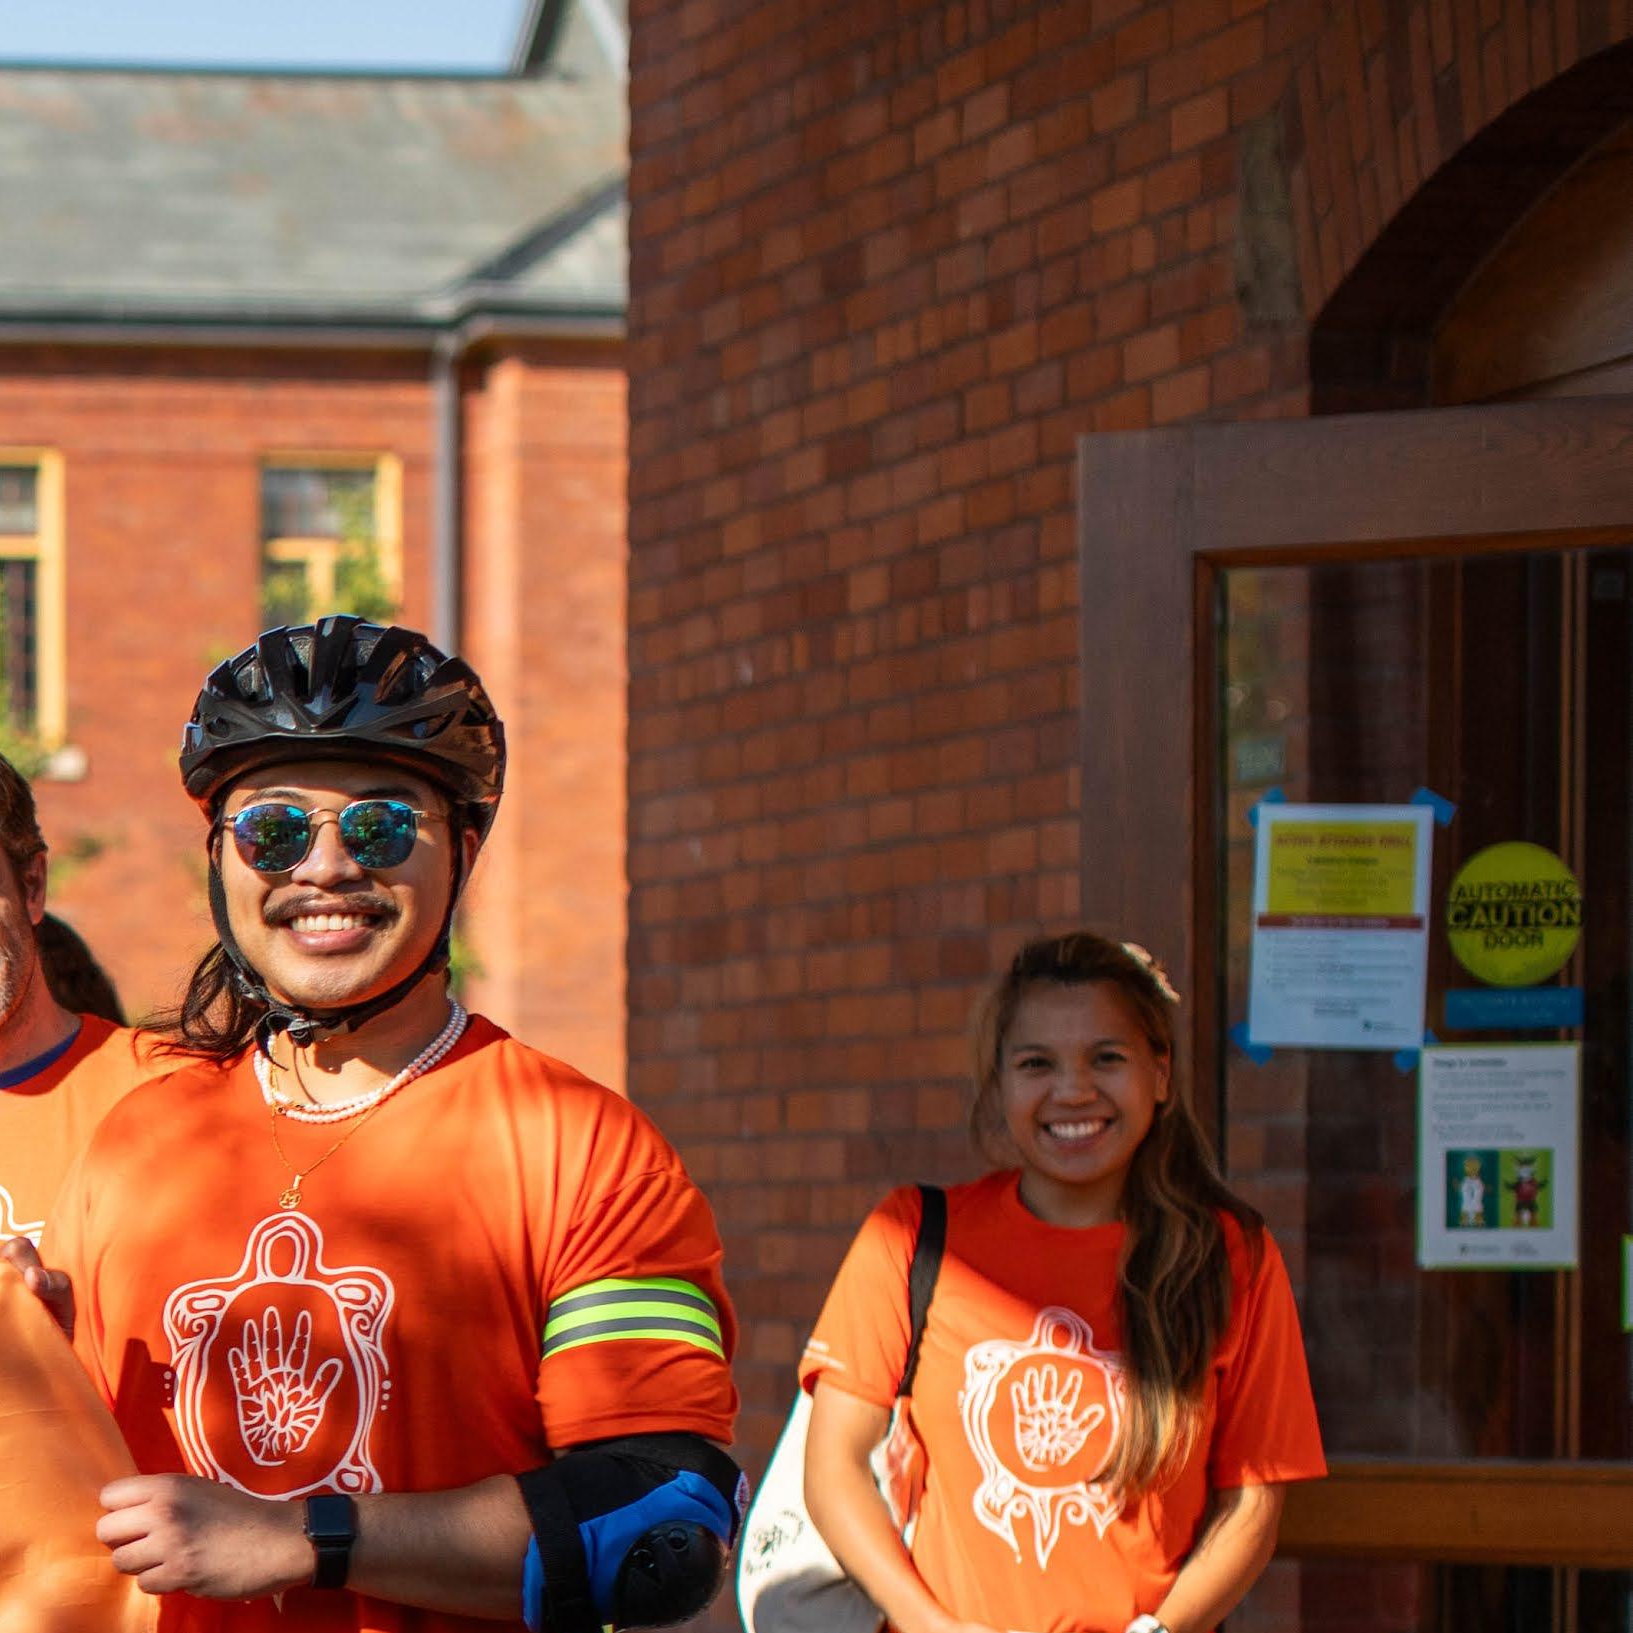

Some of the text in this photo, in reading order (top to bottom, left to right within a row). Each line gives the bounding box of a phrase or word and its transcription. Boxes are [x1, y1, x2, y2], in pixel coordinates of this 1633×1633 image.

[1455, 880, 1577, 899] AUTOMATIC
[1448, 901, 1581, 928] CAUTION
[1484, 929, 1543, 949] DOOR
